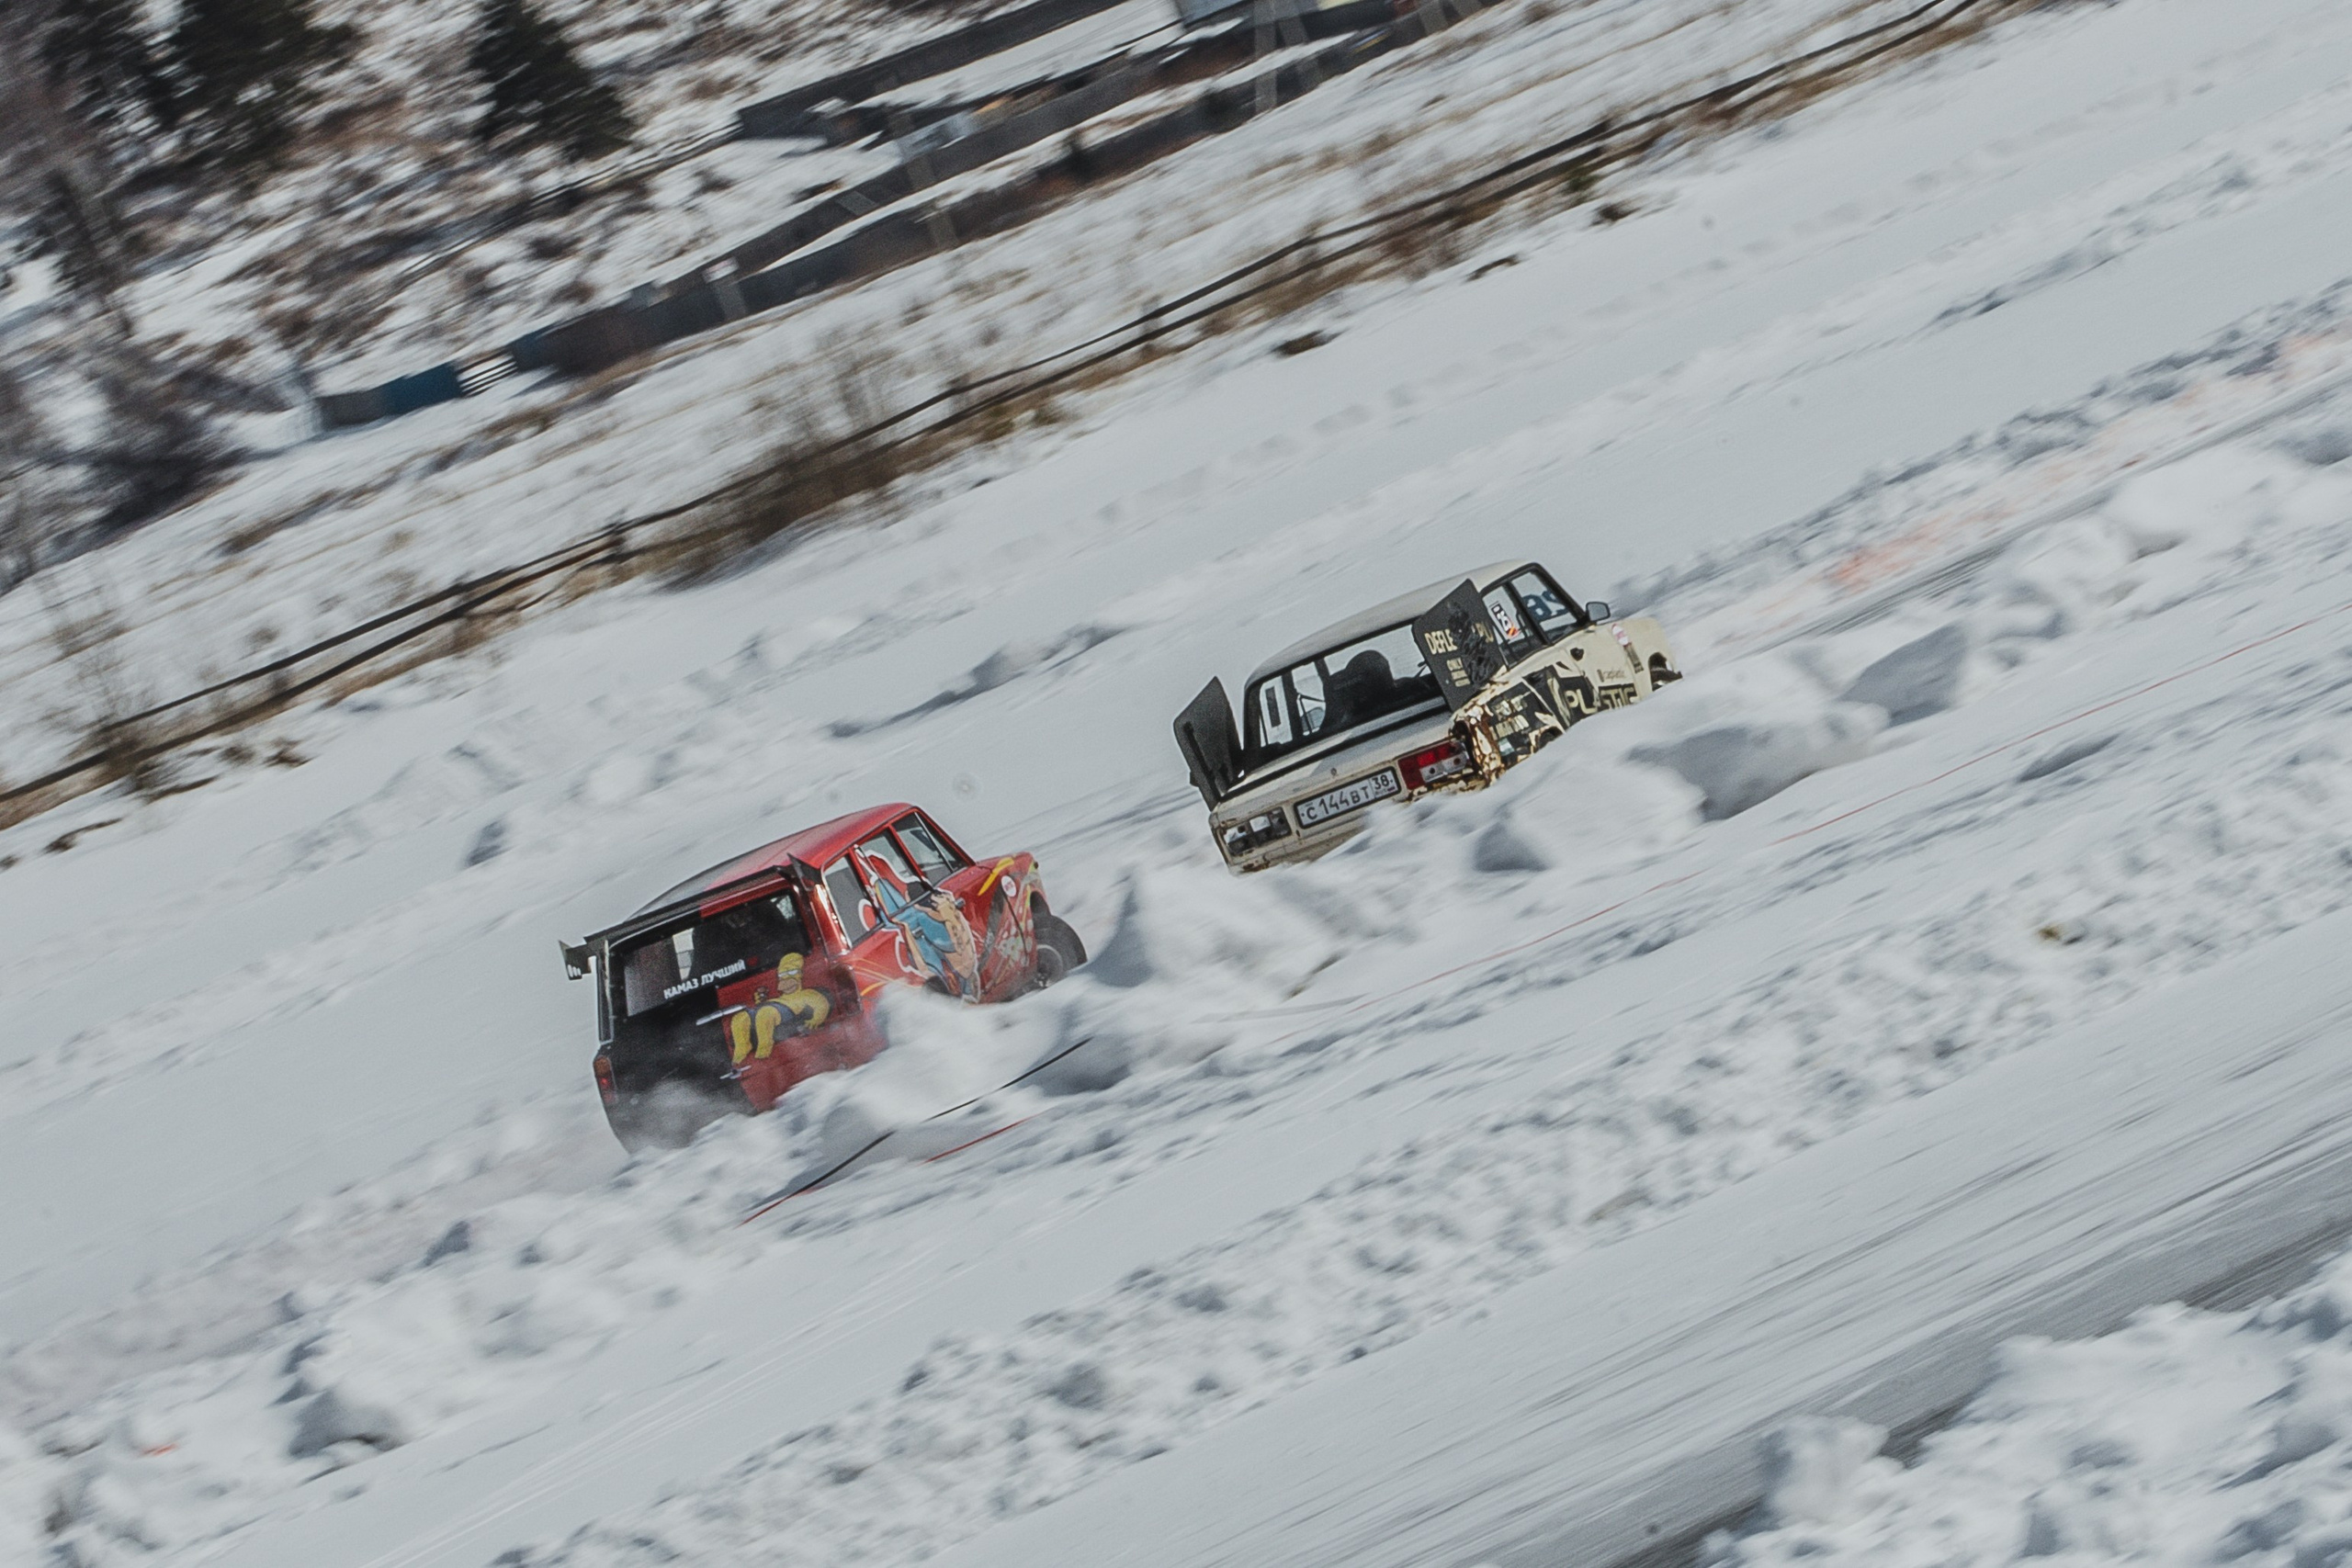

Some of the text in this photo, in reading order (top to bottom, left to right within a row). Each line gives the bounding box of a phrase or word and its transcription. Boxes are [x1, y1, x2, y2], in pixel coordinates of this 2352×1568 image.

[1306, 774, 1390, 820] С144ВТ 38
[663, 958, 746, 999] КАМАЗ ЛУЧШИЙ
